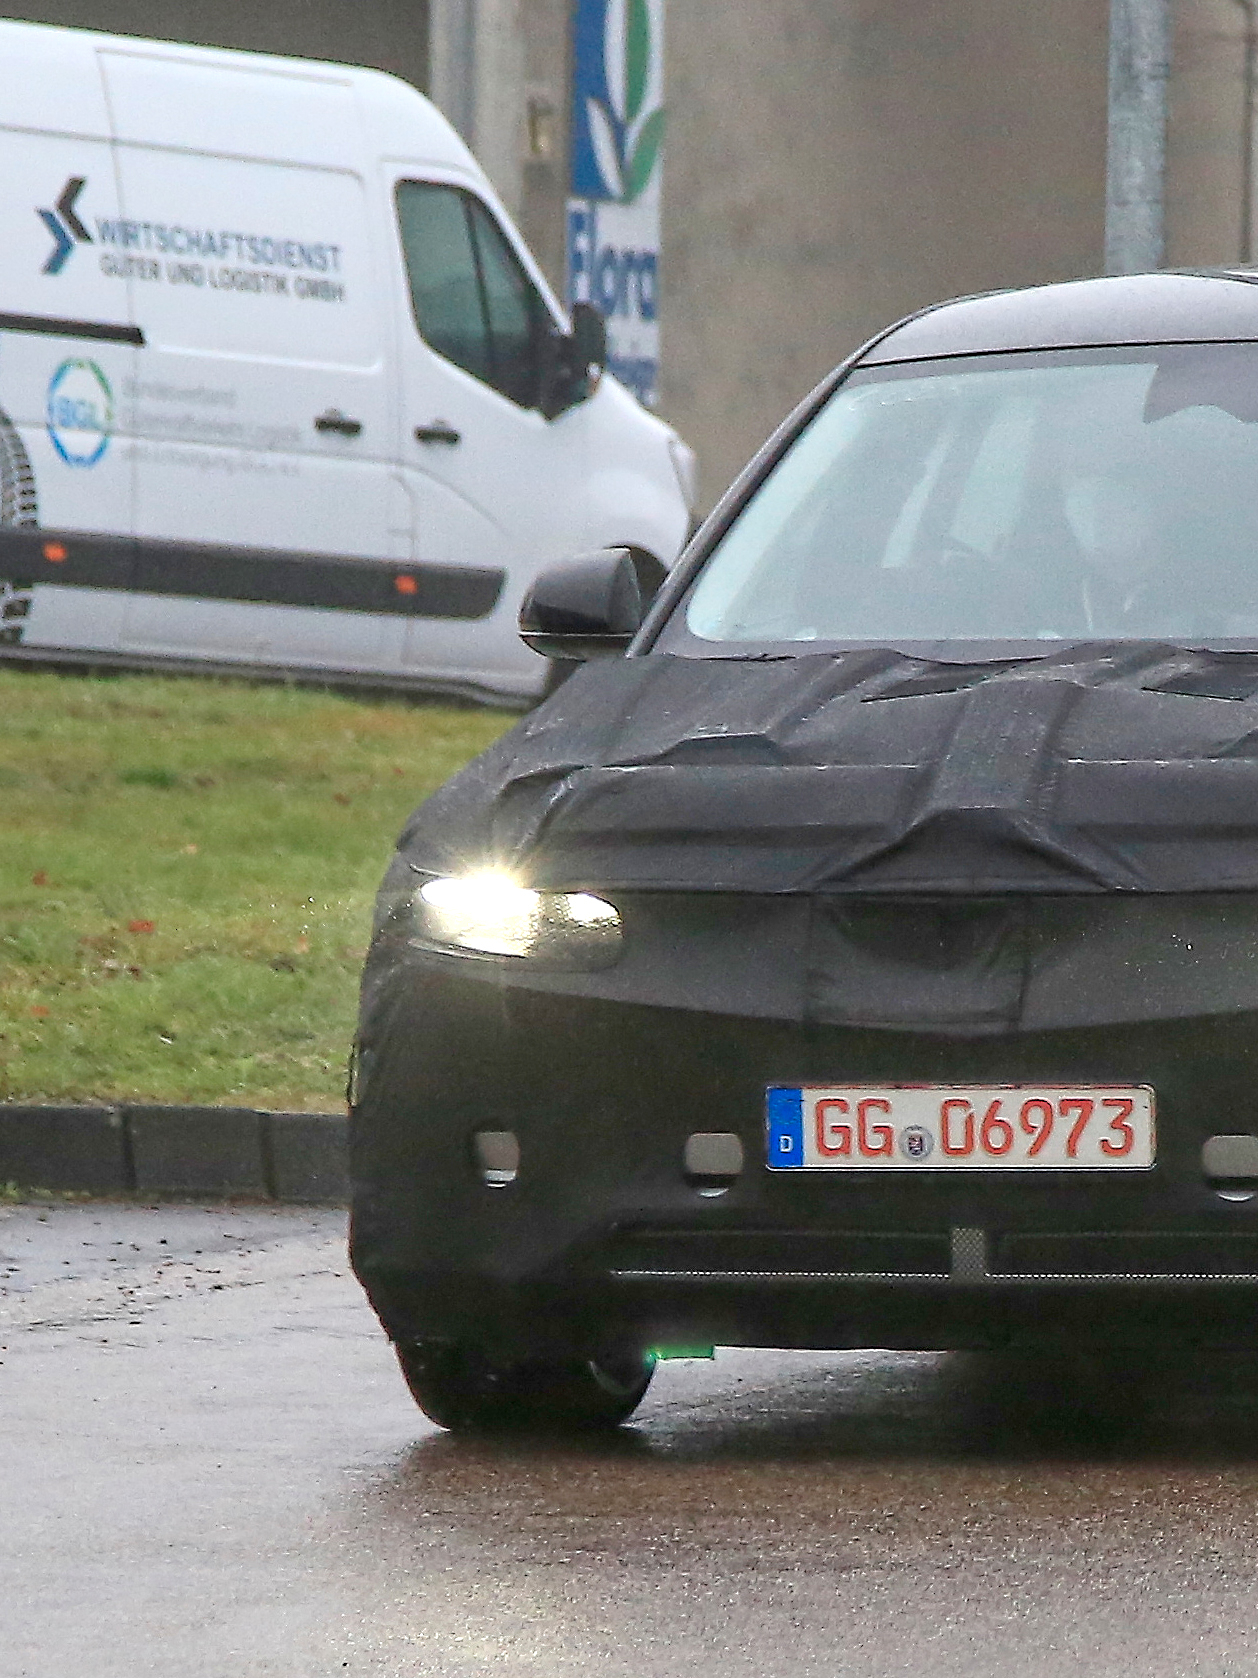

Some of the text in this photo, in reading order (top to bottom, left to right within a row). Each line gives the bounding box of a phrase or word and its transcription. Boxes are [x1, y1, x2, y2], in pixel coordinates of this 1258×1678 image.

[96, 218, 340, 272] WIRTSCHAFTSDIENST
[167, 262, 204, 287] UND
[208, 266, 289, 297] LOGISTIK
[778, 1134, 794, 1153] D
[814, 1097, 1135, 1158] GG 06973
